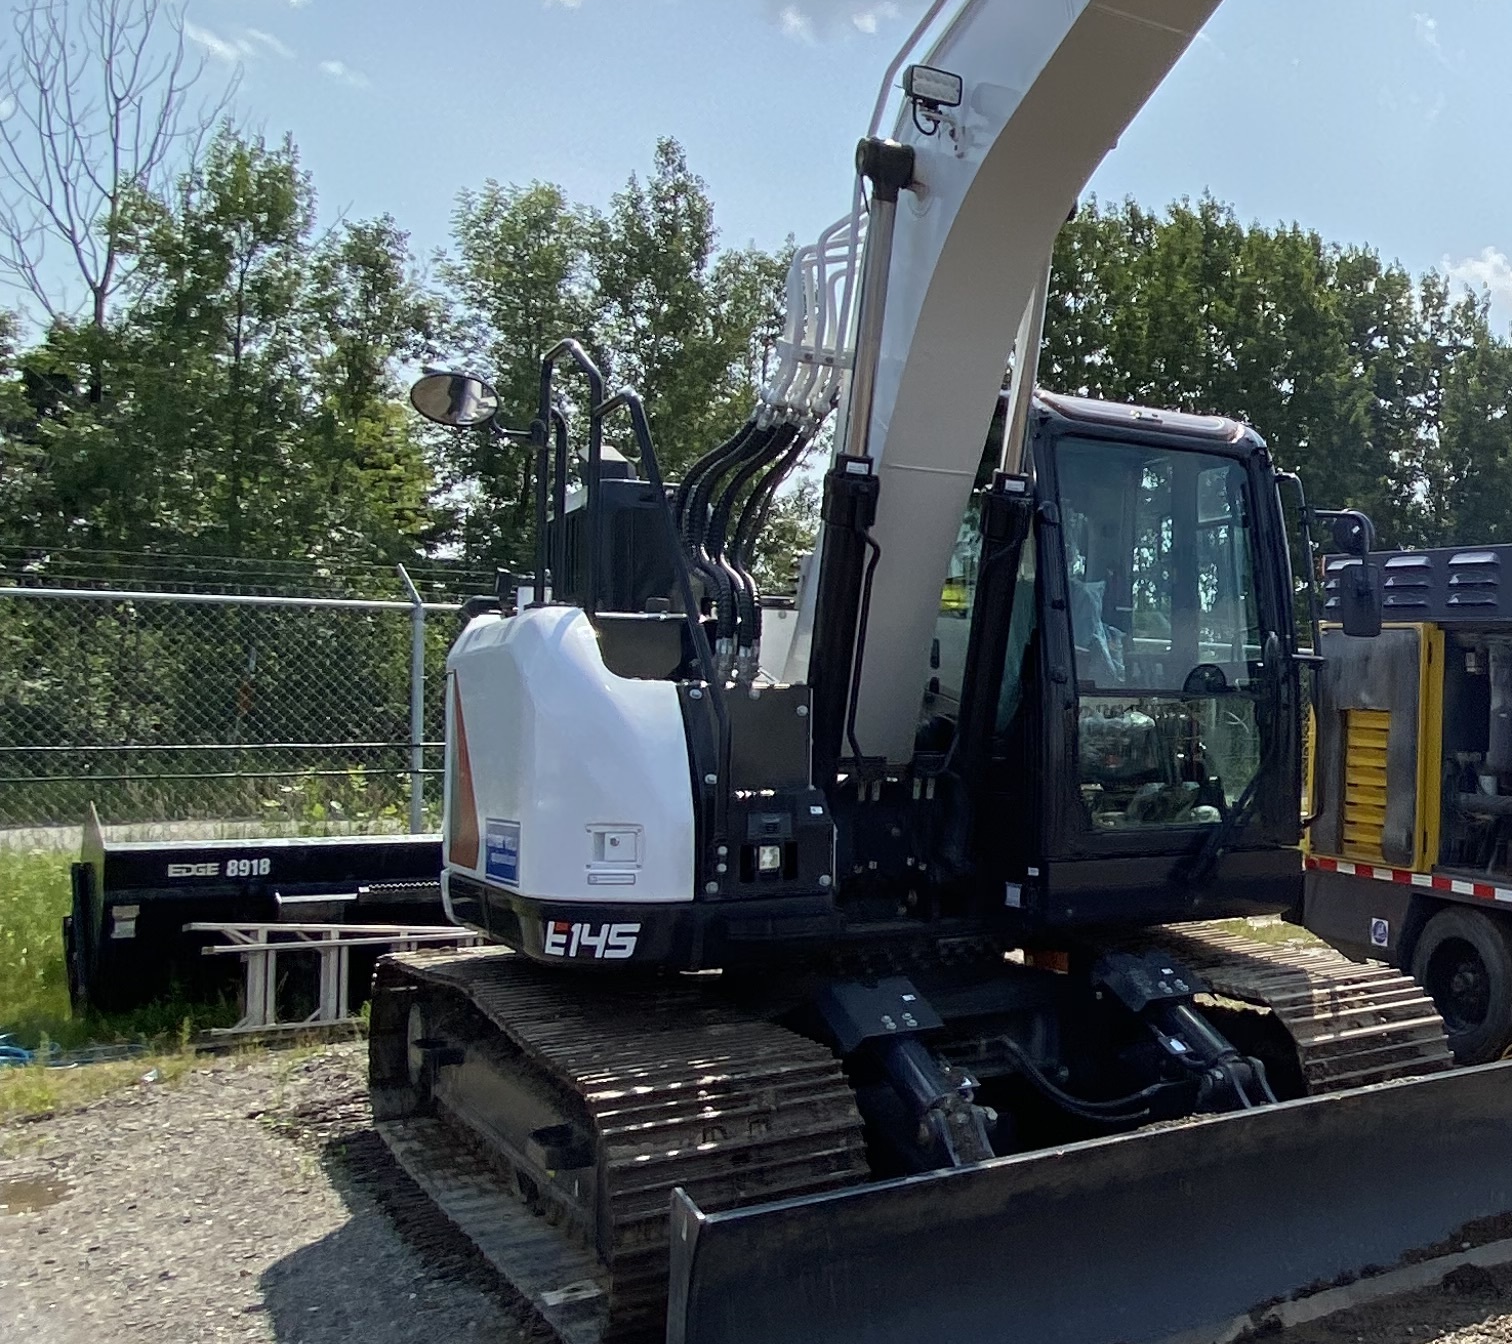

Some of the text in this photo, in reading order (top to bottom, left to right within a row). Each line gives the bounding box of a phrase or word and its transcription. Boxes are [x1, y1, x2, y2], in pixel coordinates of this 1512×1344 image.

[167, 857, 271, 878] EDGE 8918
[544, 920, 642, 959] E145
